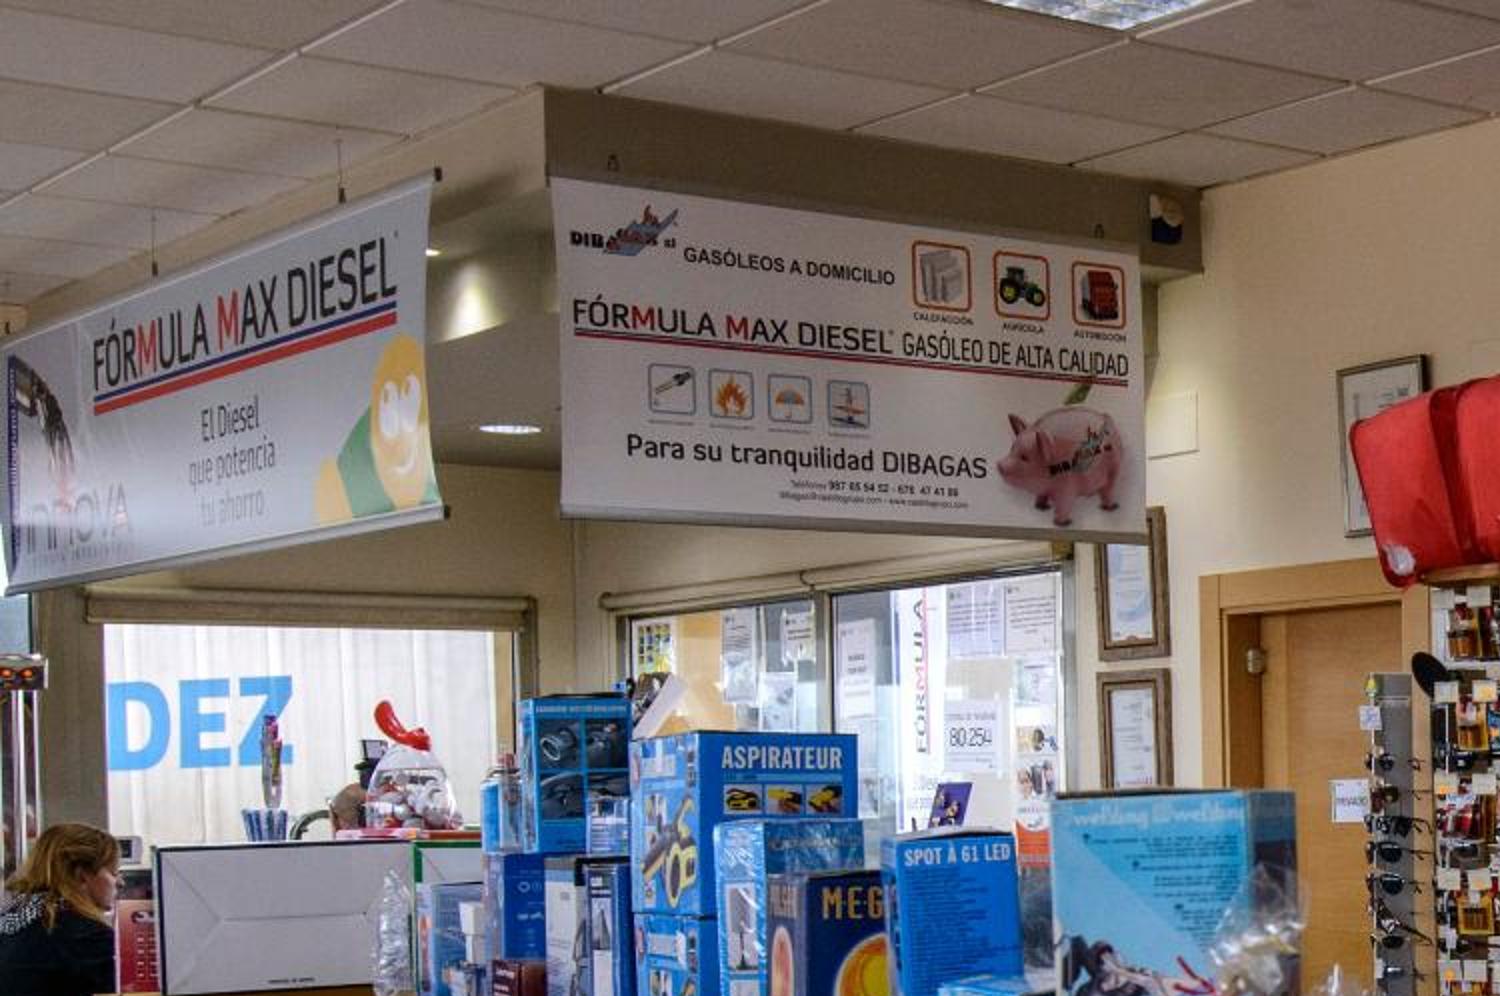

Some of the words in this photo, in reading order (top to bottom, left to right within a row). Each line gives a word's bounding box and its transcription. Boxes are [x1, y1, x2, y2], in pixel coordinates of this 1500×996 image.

[684, 247, 785, 273] GASÓLEOS
[790, 259, 802, 275] A
[807, 261, 896, 286] DOMICILIO
[94, 302, 208, 391] FÓRMULA
[216, 275, 279, 353] MAX
[287, 236, 397, 324] DIESEL
[573, 293, 715, 337] FÓRMULA
[726, 315, 788, 344] MAX
[799, 322, 892, 354] DIESEL
[902, 331, 983, 362] GASÓLEO
[989, 342, 1011, 365] DE
[1016, 345, 1054, 370] ALTA
[1059, 349, 1129, 377] CALIDAD
[201, 407, 215, 442] El
[218, 396, 260, 438] Diesel
[189, 458, 213, 493] que
[216, 437, 276, 486] potencia
[627, 434, 685, 460] Para
[694, 444, 722, 461] su
[731, 443, 874, 473] tranquilidad
[882, 452, 988, 479] DIBAGAS
[219, 489, 265, 525] ahorro
[107, 675, 294, 771] DEZ
[721, 745, 842, 769] ASPIRATEUR
[904, 847, 942, 867] SPOT
[961, 845, 979, 863] 61
[984, 843, 1011, 861] LED
